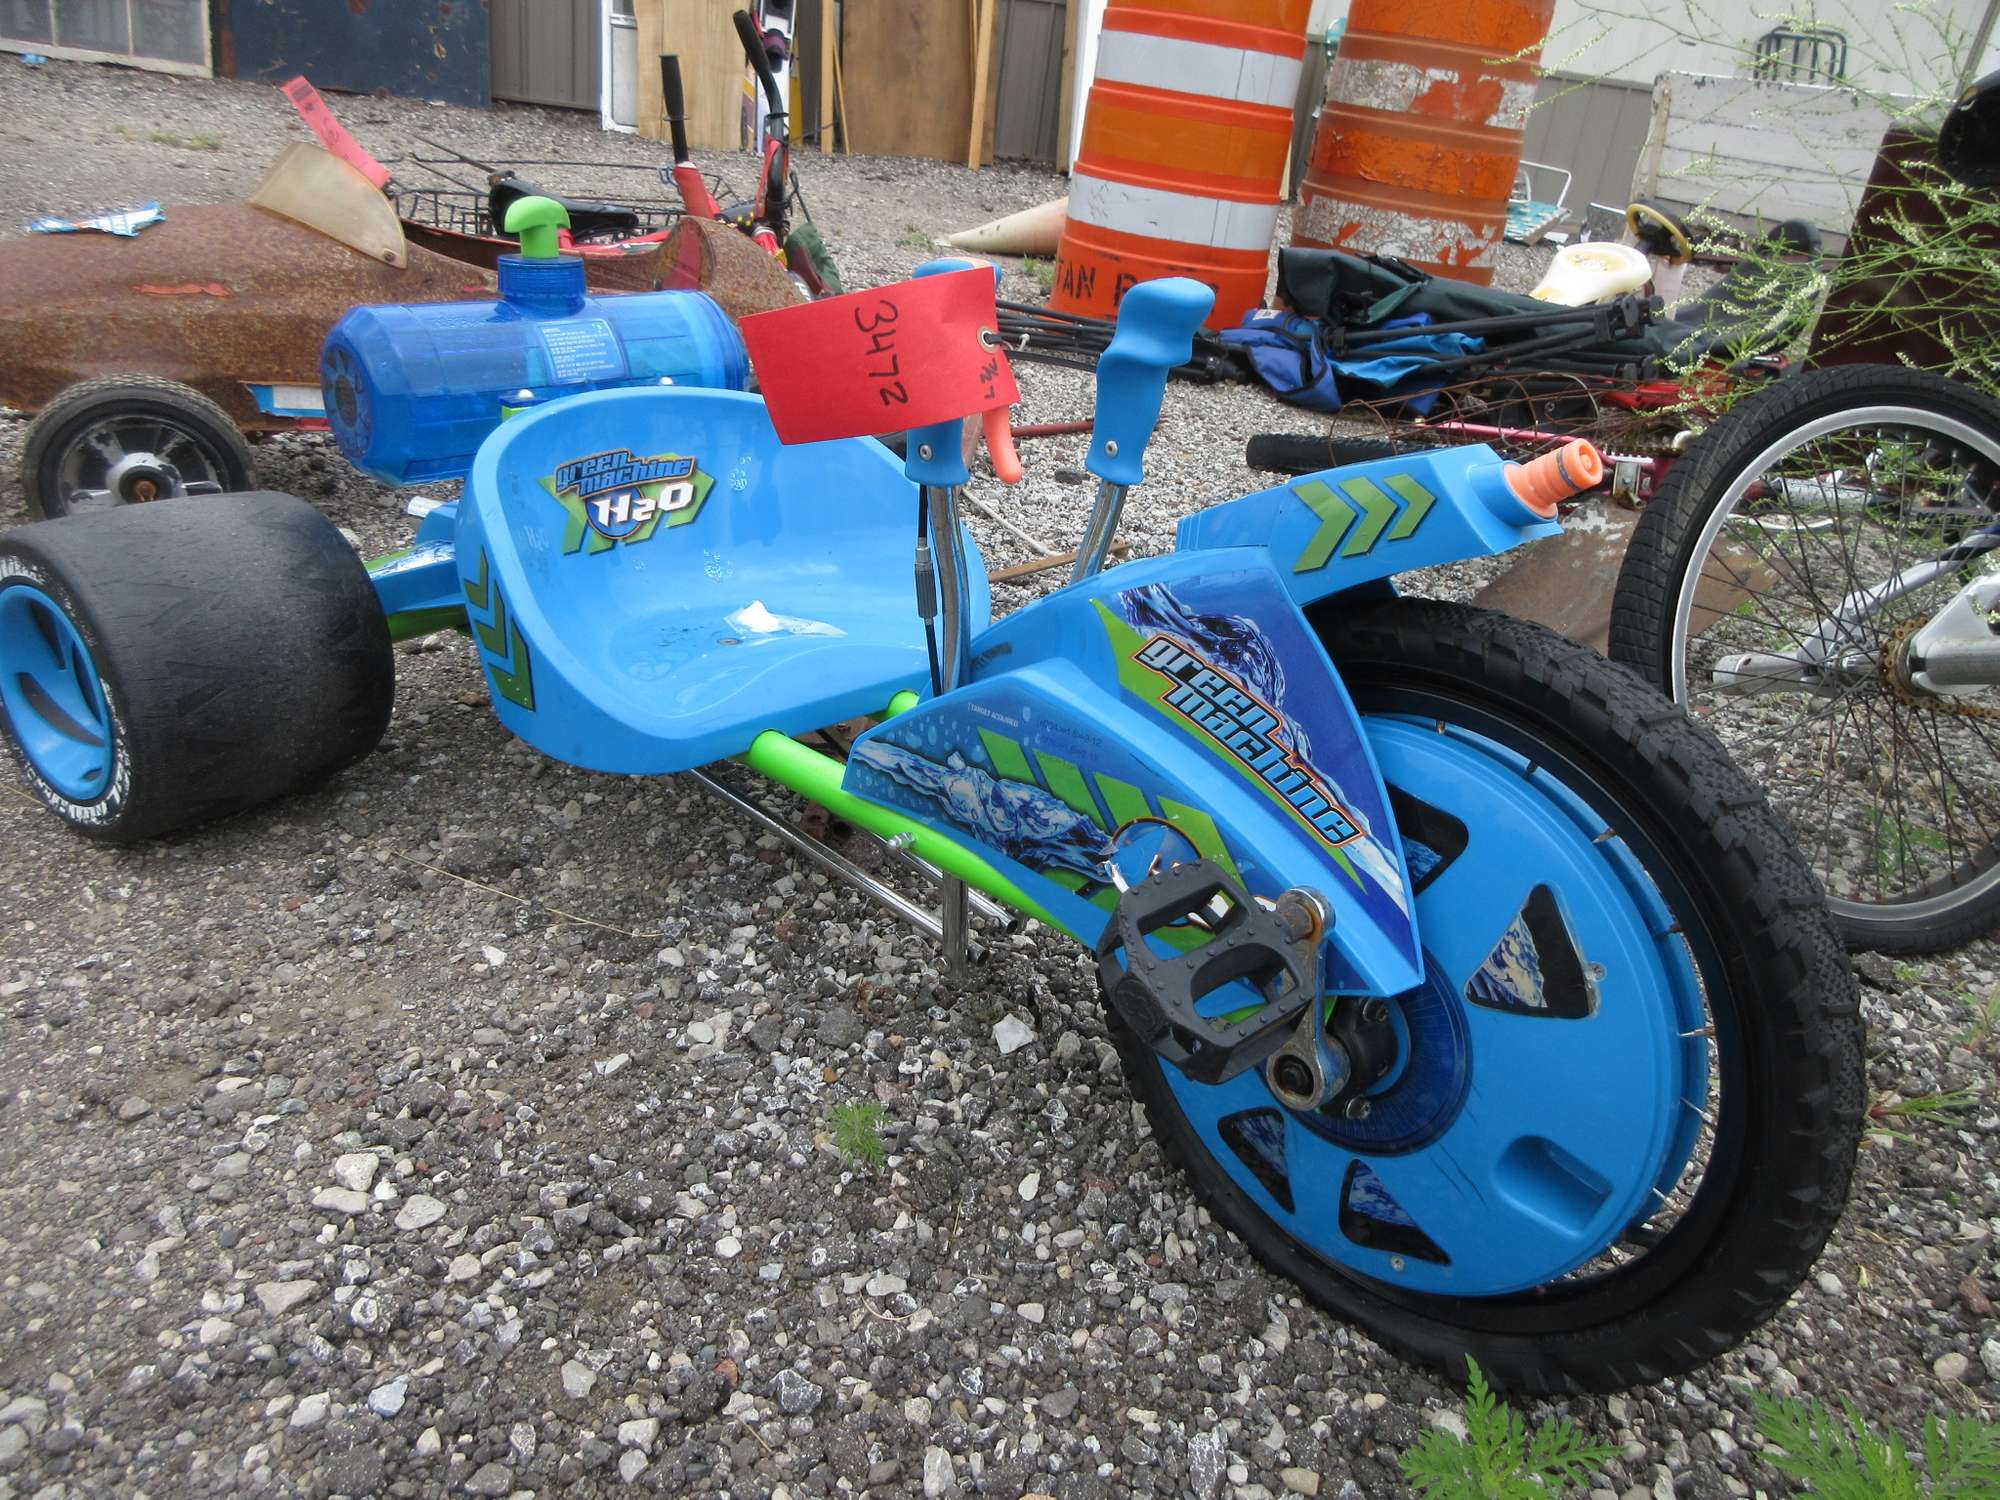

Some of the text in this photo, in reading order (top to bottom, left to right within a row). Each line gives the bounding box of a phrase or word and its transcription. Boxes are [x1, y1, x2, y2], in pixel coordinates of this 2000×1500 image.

[854, 299, 910, 407] 3472
[556, 451, 629, 491] green
[580, 458, 692, 497] machine
[591, 482, 695, 528] H2O
[1137, 637, 1280, 737] green
[1164, 684, 1360, 842] machine
